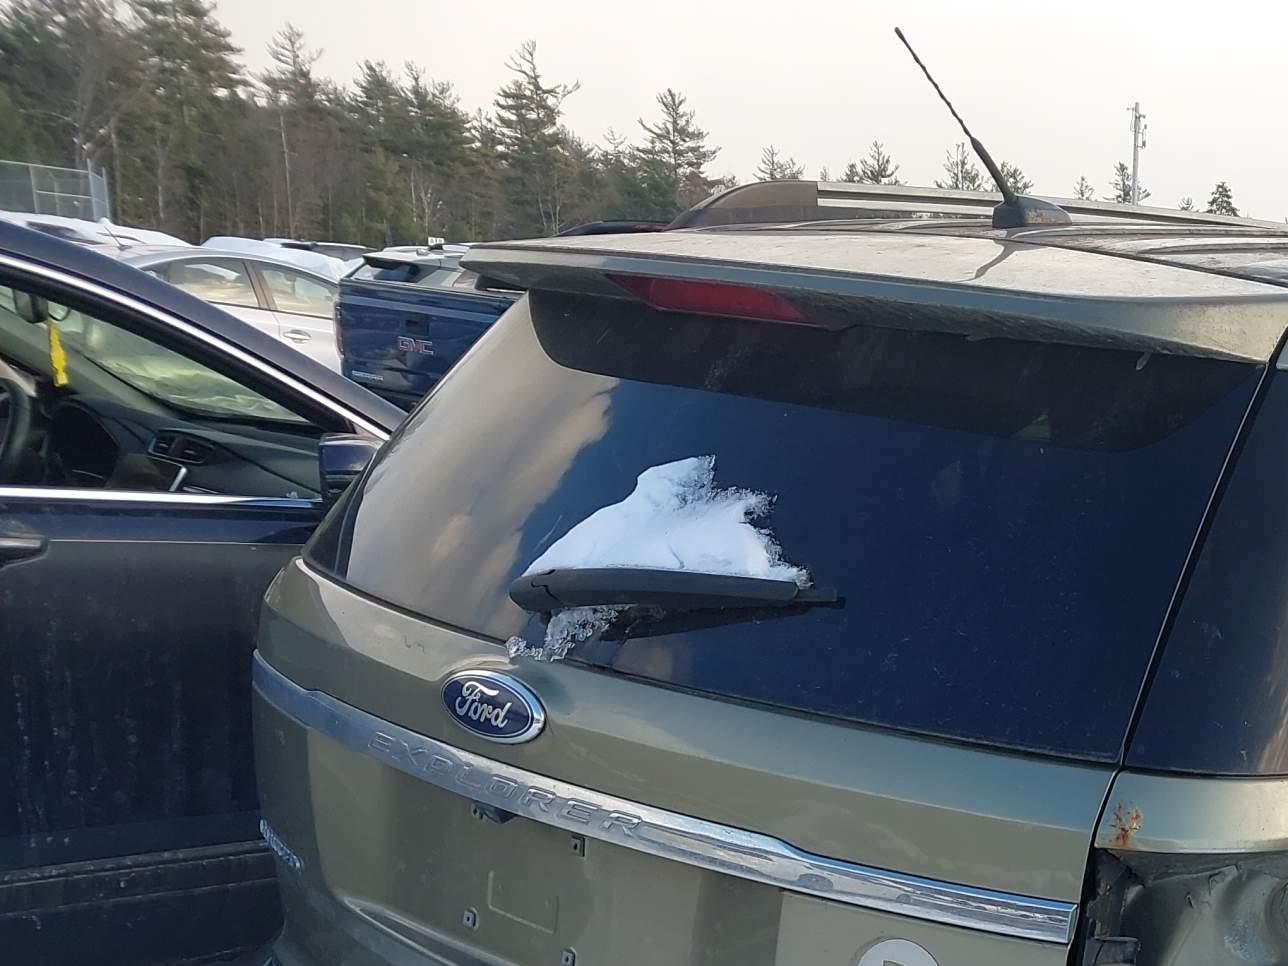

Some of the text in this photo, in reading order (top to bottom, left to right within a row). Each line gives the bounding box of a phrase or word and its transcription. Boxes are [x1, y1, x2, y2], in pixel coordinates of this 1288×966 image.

[398, 335, 434, 355] GMC
[455, 680, 513, 728] Ford
[367, 731, 644, 836] EXPLORER
